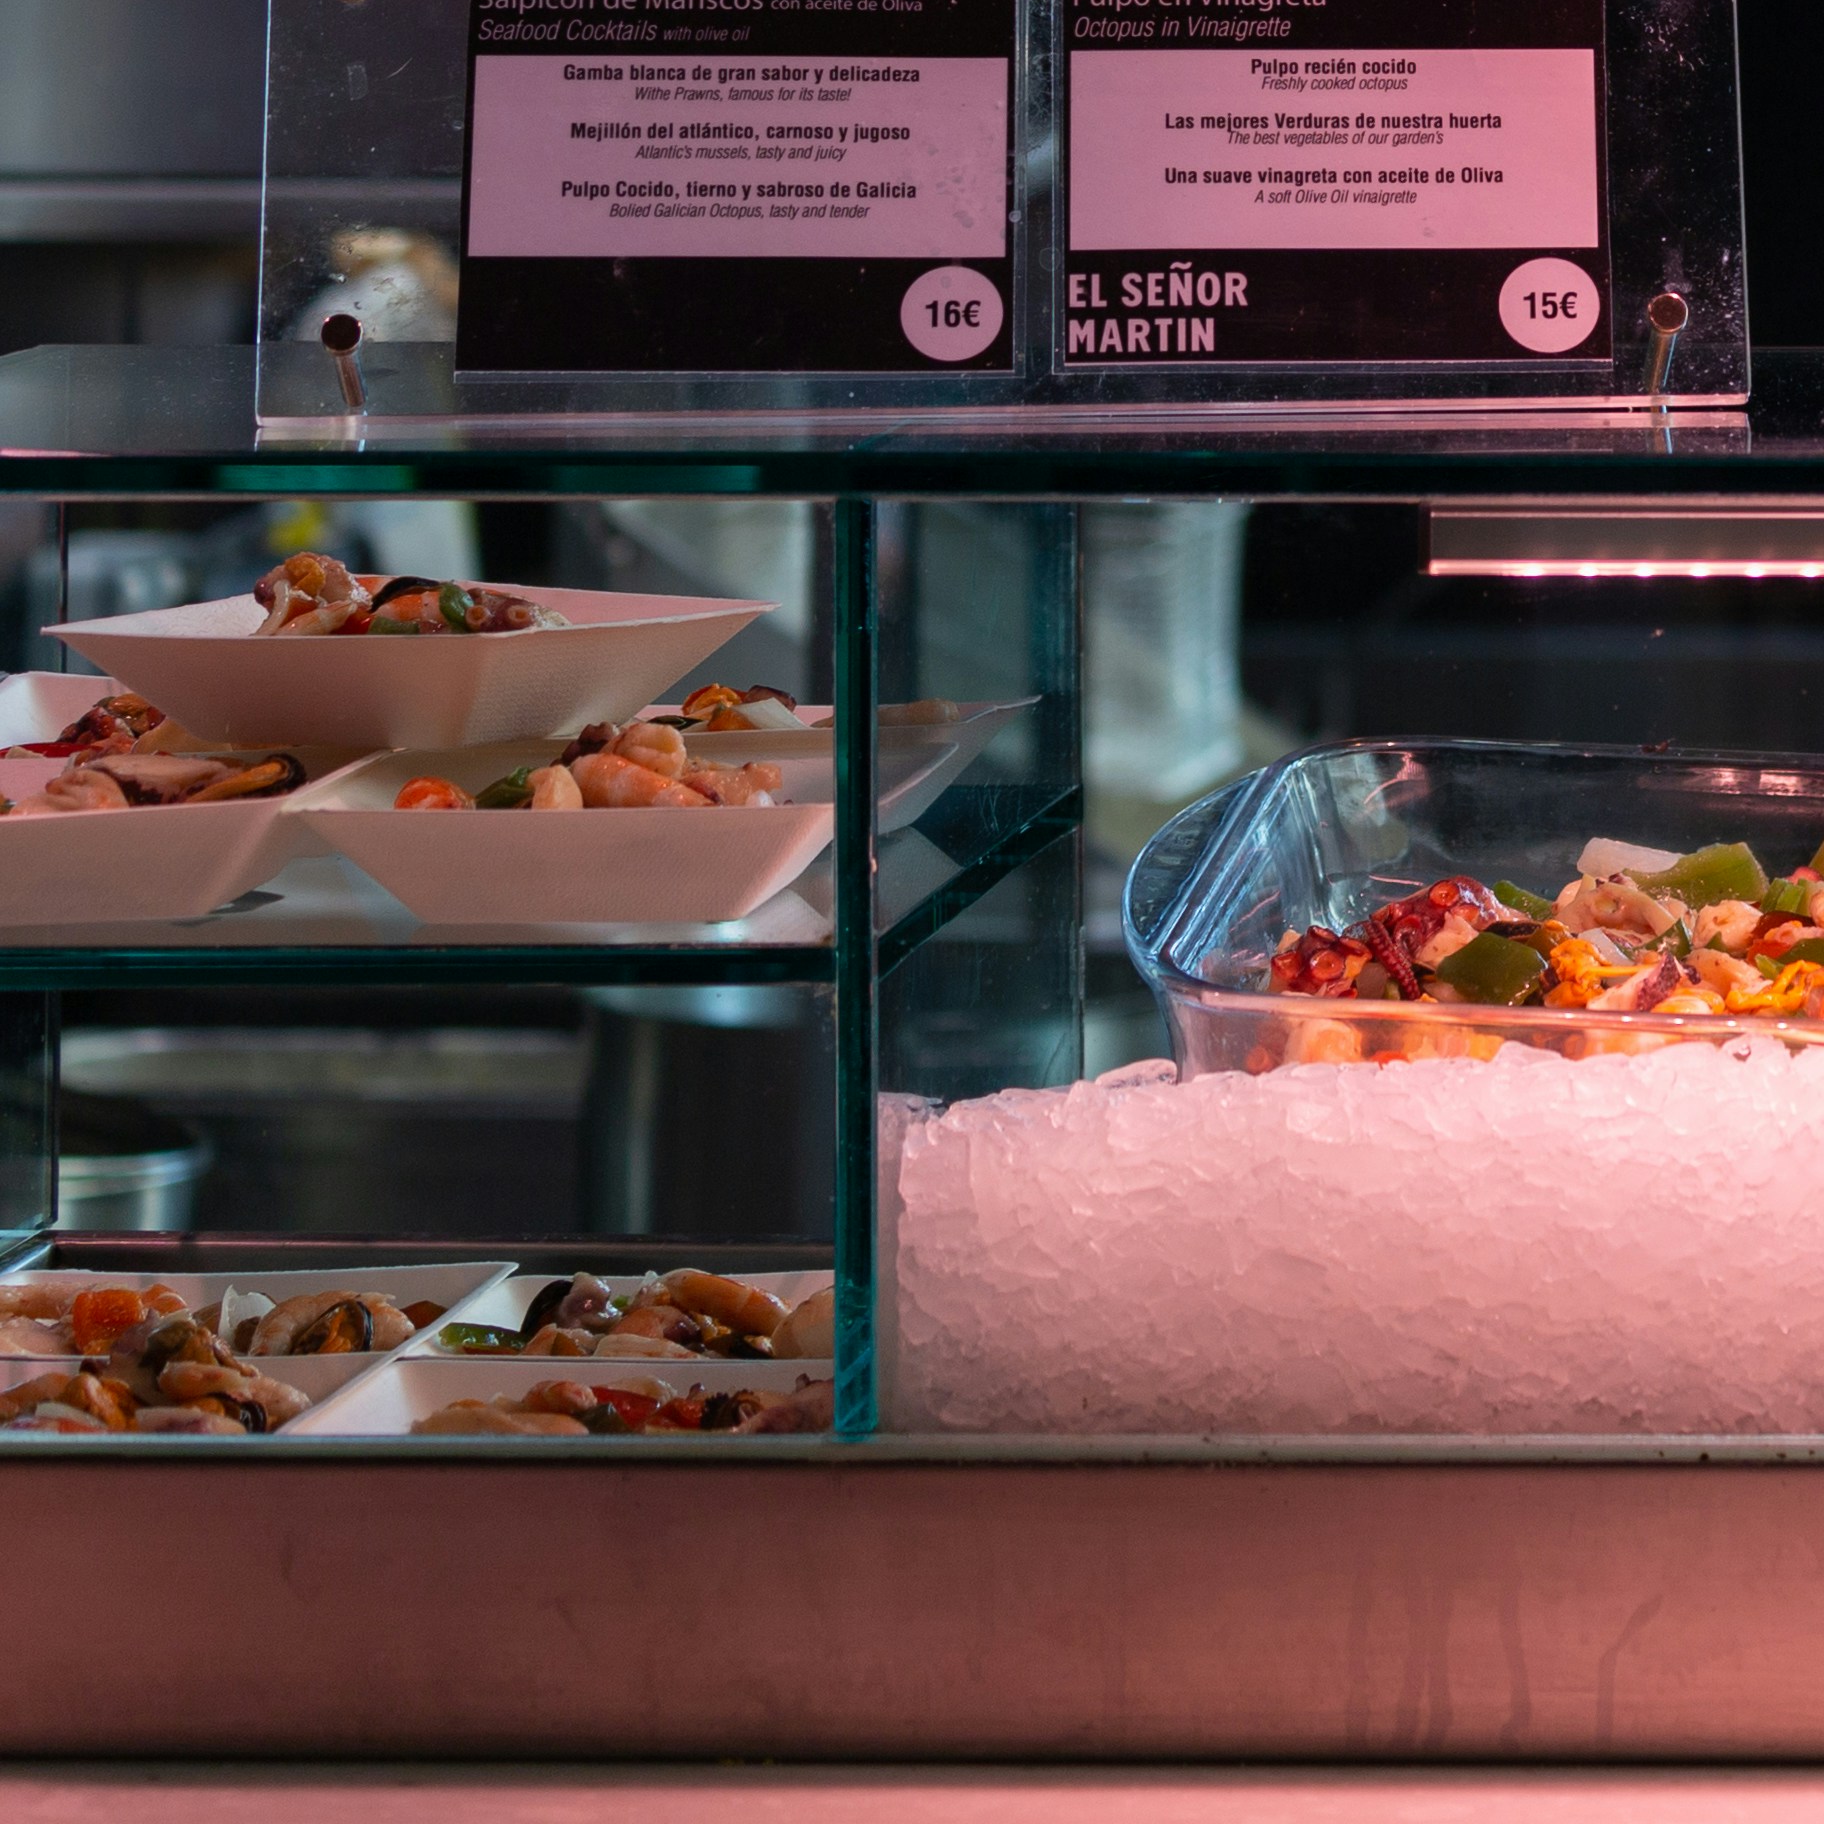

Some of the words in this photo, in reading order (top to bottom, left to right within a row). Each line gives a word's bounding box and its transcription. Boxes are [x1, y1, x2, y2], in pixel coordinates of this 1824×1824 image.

[771, 0, 801, 10] con
[478, 19, 561, 41] Seafood
[566, 19, 657, 41] Cocktails
[663, 26, 692, 41] with
[695, 26, 728, 41] olive
[732, 26, 750, 41] oil
[1074, 16, 1154, 41] Octopus
[1161, 16, 1179, 37] in
[1188, 16, 1292, 41] Vinaigrette
[563, 64, 623, 81] Gamba
[630, 64, 686, 81] blanca
[692, 65, 712, 81] de
[718, 68, 756, 84] gran
[761, 65, 809, 81] sabor
[814, 69, 824, 84] y
[829, 65, 920, 82] delicadeza
[1251, 58, 1299, 77] Pulpo
[1304, 57, 1356, 74] recién
[1362, 58, 1417, 74] cocido
[1262, 76, 1308, 92] Freshly
[1311, 76, 1355, 90] cooked
[1359, 77, 1408, 92] octopus
[635, 87, 670, 101] Withe
[674, 87, 724, 102] Prawns,
[728, 88, 774, 101] famous
[778, 88, 795, 101] for
[799, 88, 814, 101] its
[817, 88, 852, 101] taste!
[570, 122, 642, 142] Mejillón
[647, 123, 673, 139] del
[679, 122, 759, 141] atlántico,
[766, 127, 834, 140] carnoso
[839, 127, 848, 143] y
[853, 123, 911, 143] jugoso
[1165, 113, 1194, 129] Las
[1200, 113, 1269, 132] mejores
[1275, 113, 1350, 129] Verduras
[1355, 113, 1375, 129] de
[1381, 115, 1443, 129] nuestra
[1449, 113, 1502, 129] huerta
[1228, 131, 1250, 144] The
[1253, 131, 1281, 144] best
[1284, 131, 1348, 147] vegetables
[1352, 131, 1365, 144] of
[1368, 133, 1388, 144] our
[695, 145, 751, 160] mussels,
[755, 146, 785, 161] tasty
[788, 146, 812, 159] and
[814, 146, 848, 162] juicy
[1165, 168, 1197, 183] Una
[1203, 170, 1252, 183] suave
[1257, 168, 1337, 186] vinagreta
[1343, 170, 1372, 183] con
[1378, 167, 1429, 183] aceite
[1435, 167, 1455, 183] de
[1461, 167, 1503, 183] Oliva
[561, 181, 610, 201] Pulpo
[615, 180, 680, 200] Cocido,
[686, 181, 737, 197] tierno
[742, 185, 751, 201] y
[756, 181, 824, 198] sabroso
[830, 182, 850, 198] de
[856, 181, 917, 199] Galicia
[1254, 191, 1265, 203] A
[1268, 190, 1292, 204] soft
[1295, 190, 1327, 204] Olive
[1330, 190, 1349, 204] Oil
[1353, 190, 1417, 206] vinaigrette
[654, 203, 706, 218] Galician
[710, 203, 764, 219] Octopus,
[769, 204, 799, 219] tasty
[802, 204, 827, 218] and
[829, 205, 870, 218] tender
[1069, 274, 1107, 307] EL
[1121, 261, 1249, 307] SEÑOR
[925, 299, 981, 329] 16€
[1523, 292, 1578, 320] 15€
[1069, 318, 1216, 353] MARTIN
